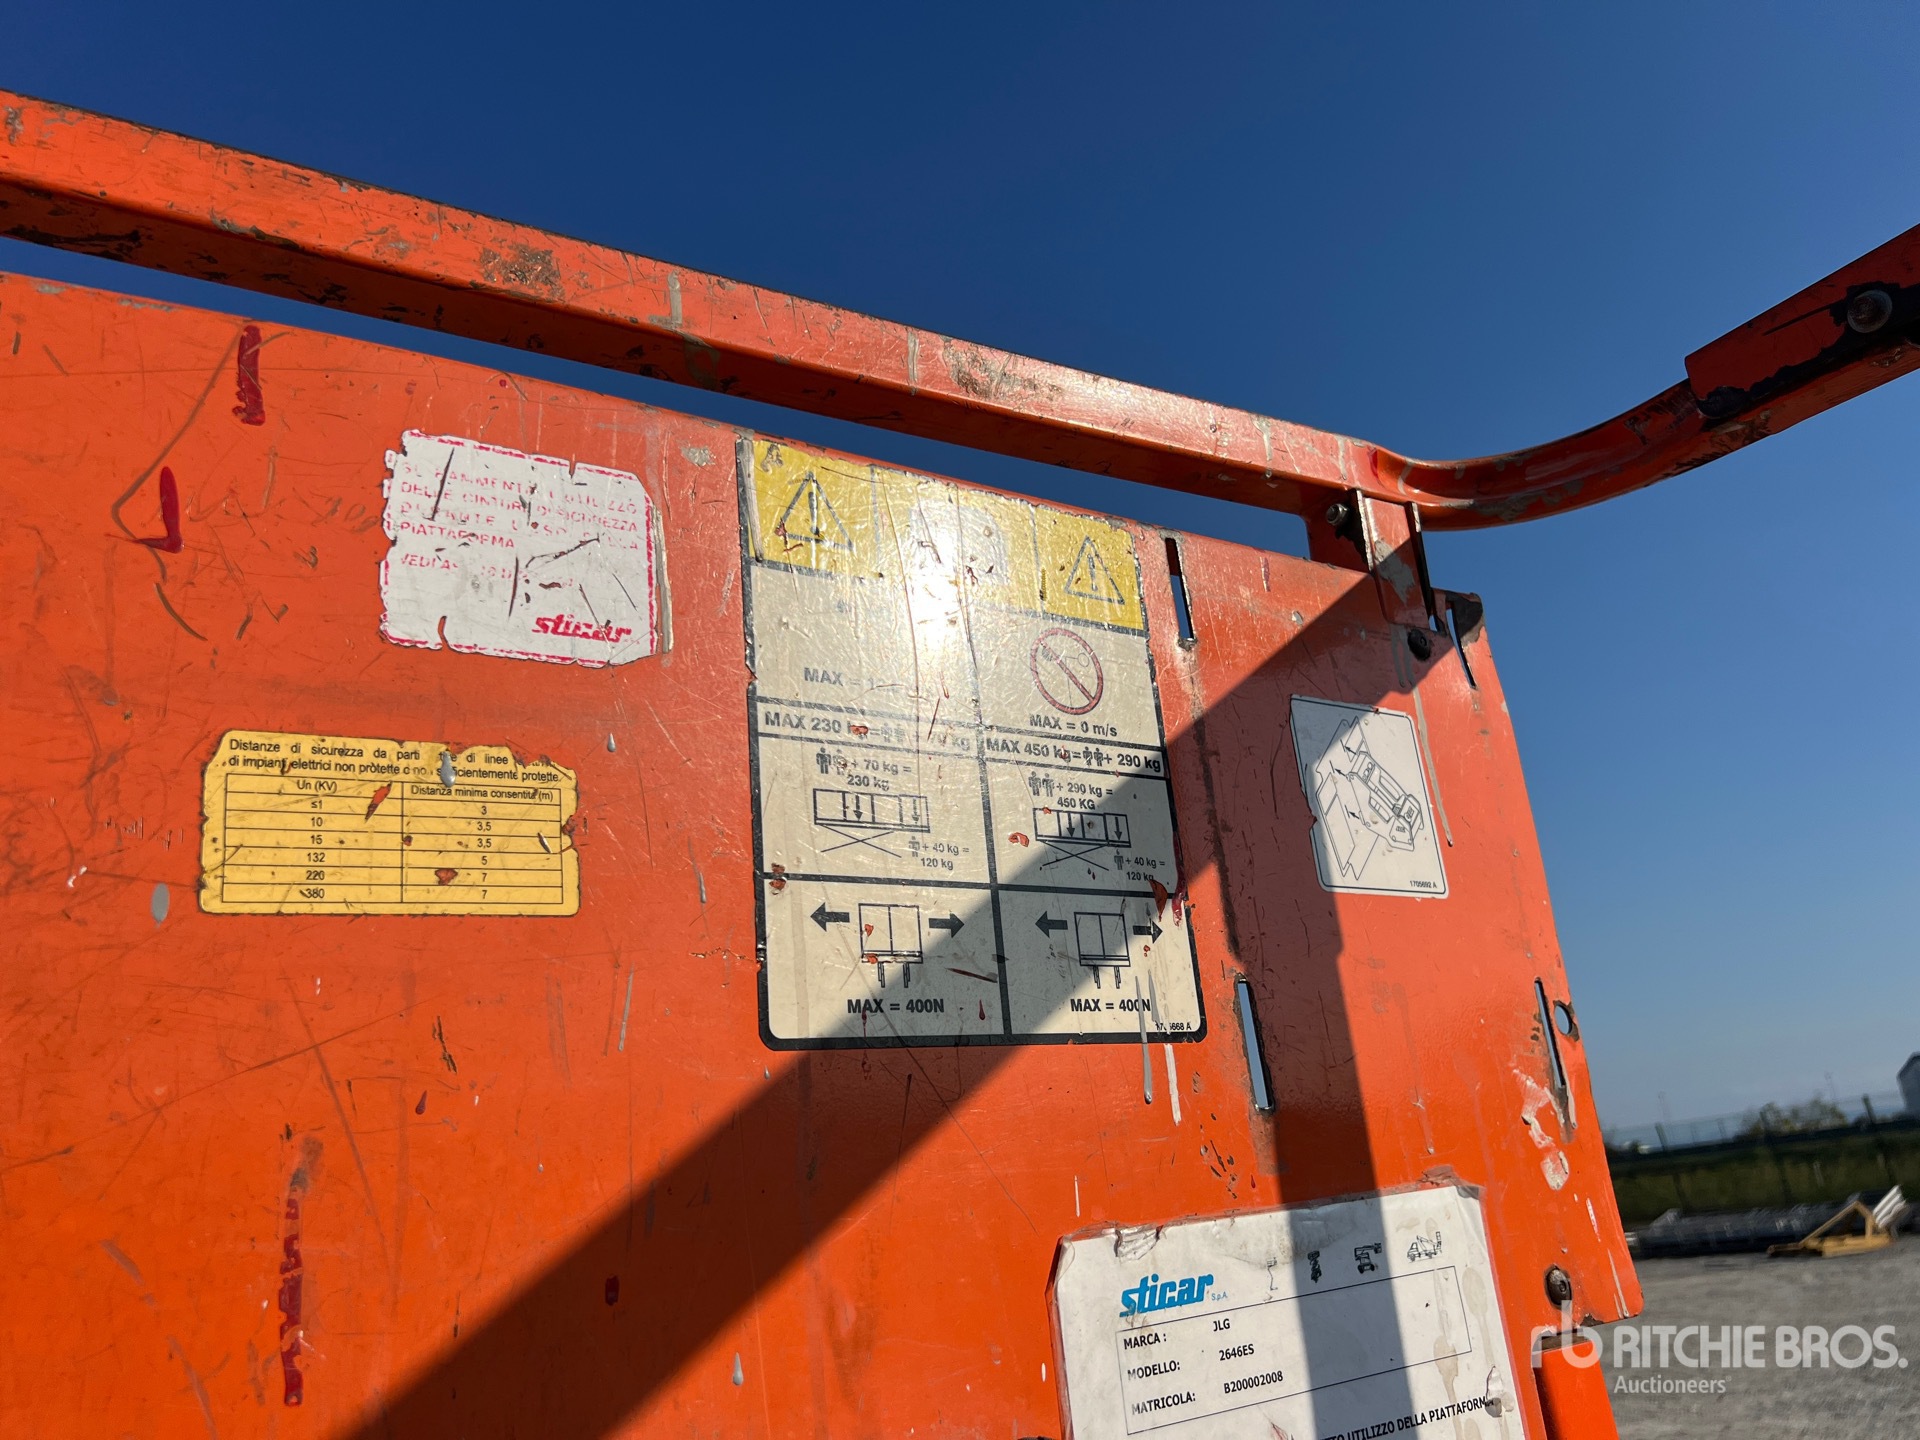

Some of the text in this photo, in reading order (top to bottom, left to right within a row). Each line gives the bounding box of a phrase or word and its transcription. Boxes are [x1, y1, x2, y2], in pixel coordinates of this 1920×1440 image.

[804, 667, 843, 686] MAX
[765, 711, 806, 730] MAX
[811, 717, 842, 733] 230
[1029, 714, 1062, 730] MAX
[1081, 720, 1089, 733] 0
[1093, 723, 1117, 737] m/s
[230, 739, 280, 753] Distanze
[290, 742, 301, 754] di
[311, 744, 364, 758] sicurezza
[373, 748, 387, 758] da
[397, 750, 420, 762] parti
[466, 752, 475, 763] di
[485, 753, 508, 764] linee
[986, 737, 1020, 754] MAX
[1024, 744, 1049, 757] 450
[1117, 754, 1141, 768] 290
[1144, 756, 1161, 772] kg
[229, 756, 239, 767] di
[291, 758, 331, 771] elettrici
[335, 763, 355, 773] non
[359, 762, 399, 775] protette
[864, 759, 879, 771] 70
[883, 760, 898, 775] kg
[296, 780, 337, 793] Un (KV)
[847, 775, 889, 791] 230 kg
[1067, 782, 1086, 794] 290
[1089, 784, 1102, 797] kg
[411, 785, 451, 796] Distanza
[455, 787, 488, 798] minima
[538, 790, 553, 801] (m)
[481, 805, 488, 815] 3
[1057, 797, 1095, 810] 450 KG
[311, 817, 323, 827] 10
[477, 821, 492, 832] 3,5
[310, 834, 323, 844] 15
[477, 838, 492, 848] 3,5
[933, 843, 944, 852] 40
[947, 844, 959, 856] kg
[307, 852, 326, 862] 132
[481, 855, 488, 865] 5
[1134, 857, 1144, 866] 40
[1146, 857, 1157, 869] kg
[921, 858, 953, 870] 120 kg
[306, 870, 325, 880] 220
[482, 872, 488, 882] 7
[1126, 872, 1141, 880] 120
[306, 888, 325, 898] 380
[482, 889, 488, 899] 7
[847, 999, 884, 1013] MAX
[906, 998, 944, 1013] 400N
[1070, 999, 1101, 1012] MAX
[1186, 1022, 1191, 1030] A
[1119, 1273, 1214, 1317] sticar
[1213, 1318, 1231, 1332] JLG
[1123, 1332, 1160, 1350] MARCA
[1219, 1343, 1255, 1361] 2646ES
[1127, 1360, 1180, 1381] MODELLO:
[1224, 1370, 1283, 1394] B200002008
[1132, 1391, 1196, 1415] MATRICOLA:
[1347, 1418, 1395, 1440] UTILIZZO
[1397, 1412, 1427, 1431] DELLA
